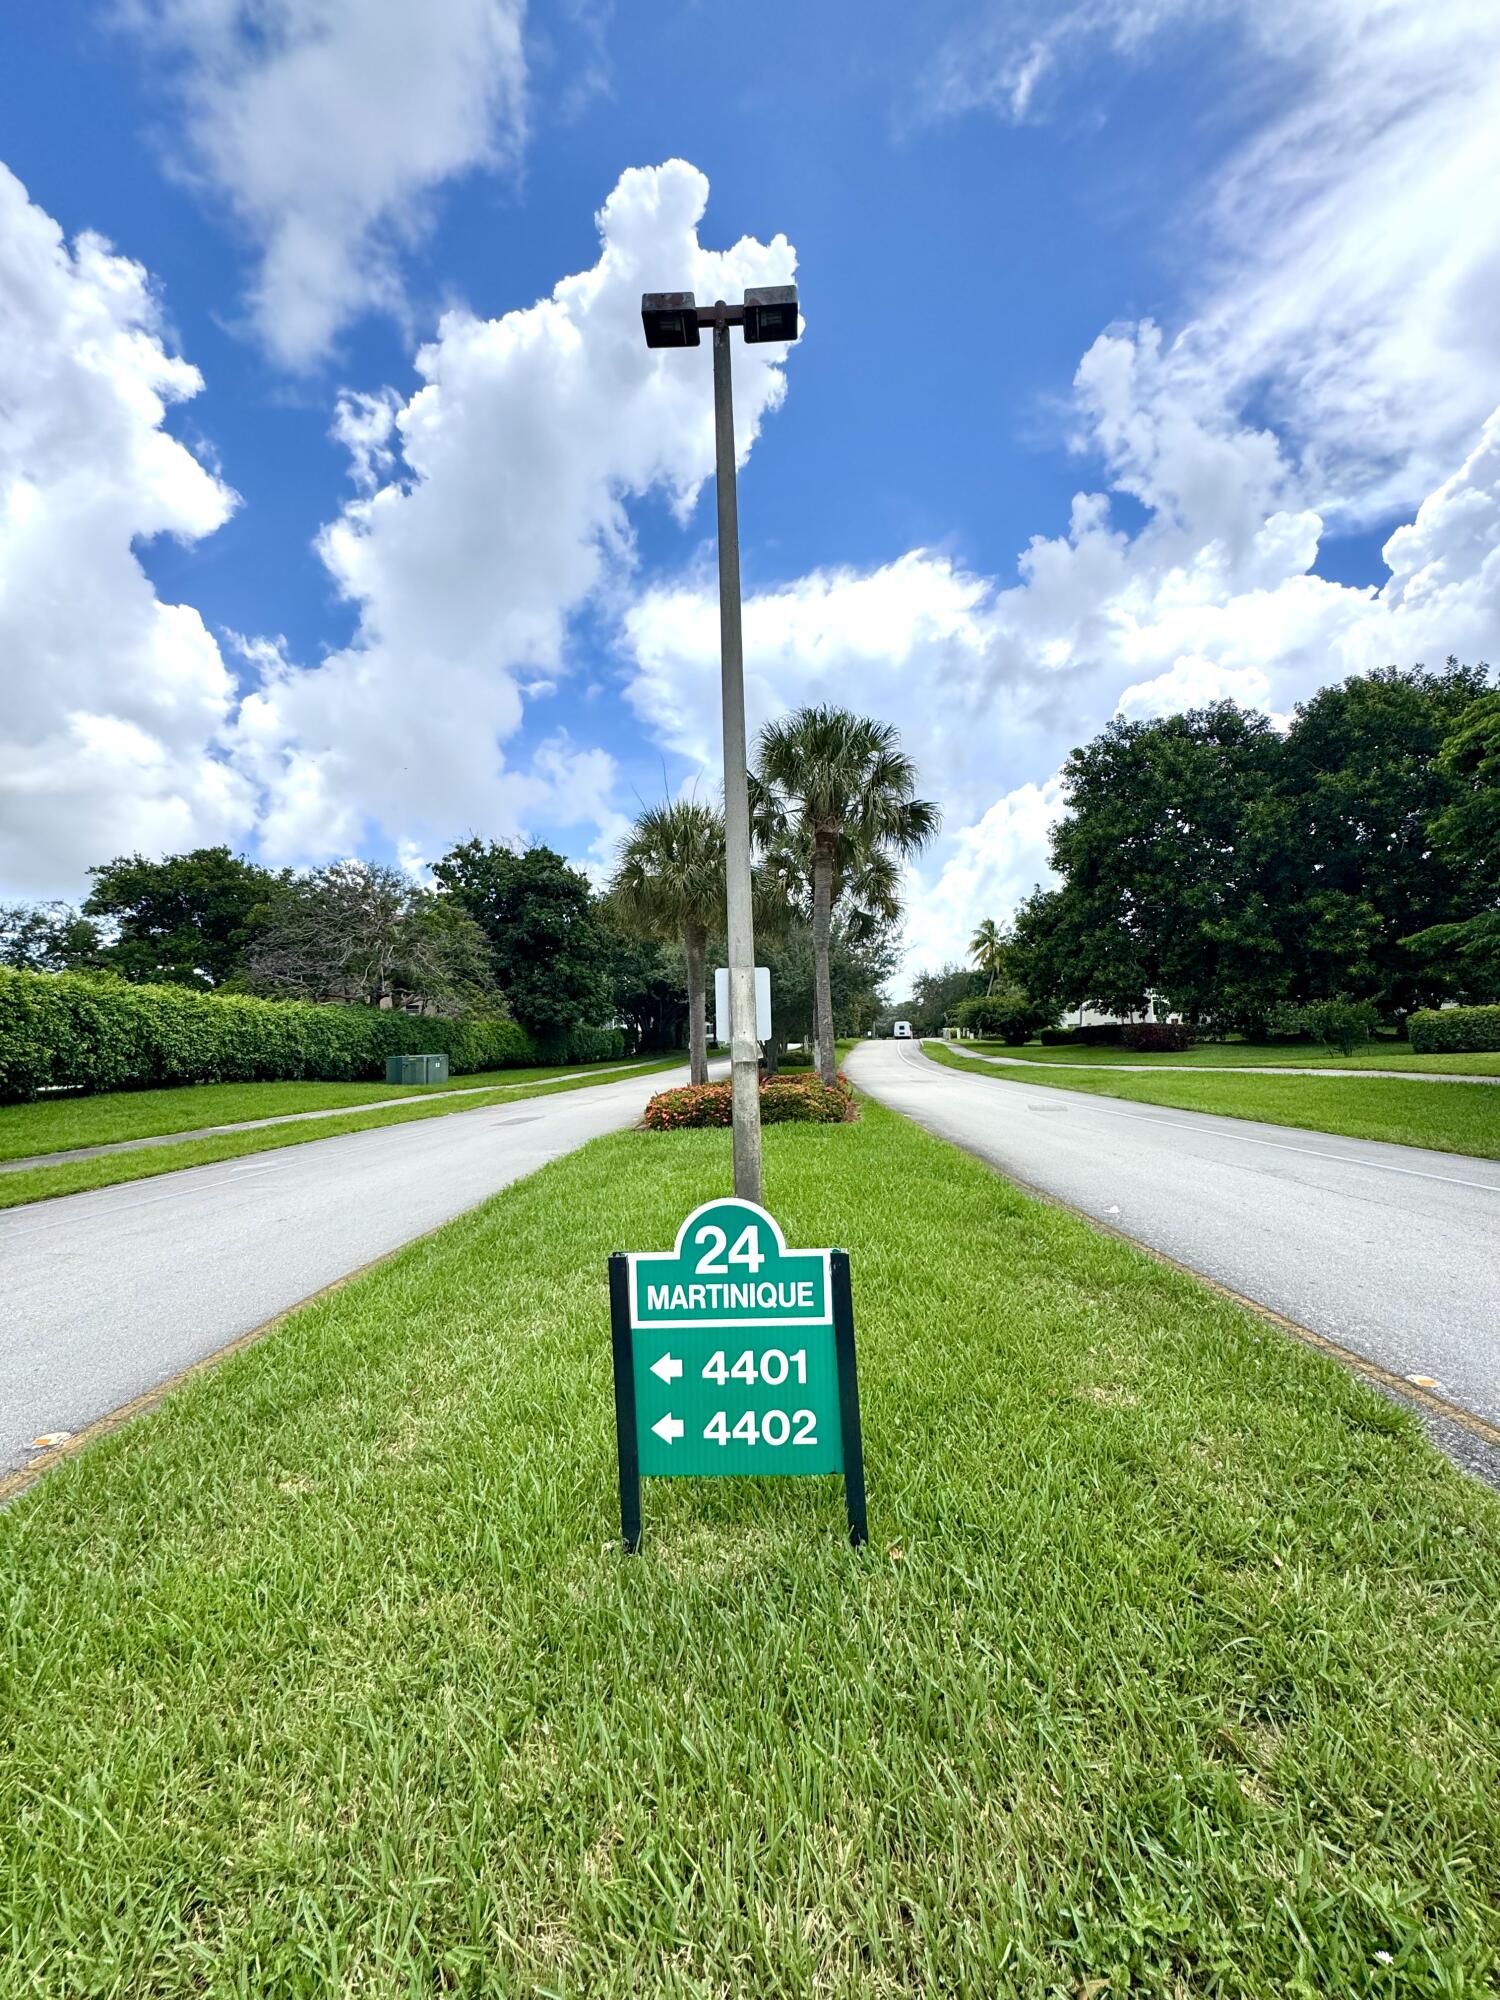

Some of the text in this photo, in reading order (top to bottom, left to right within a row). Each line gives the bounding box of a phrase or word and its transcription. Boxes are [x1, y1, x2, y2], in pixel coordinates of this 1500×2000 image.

[694, 1225, 765, 1274] 24
[647, 1281, 814, 1310] MARTINIQUE
[701, 1349, 807, 1385] 4401
[703, 1409, 818, 1446] 4402
